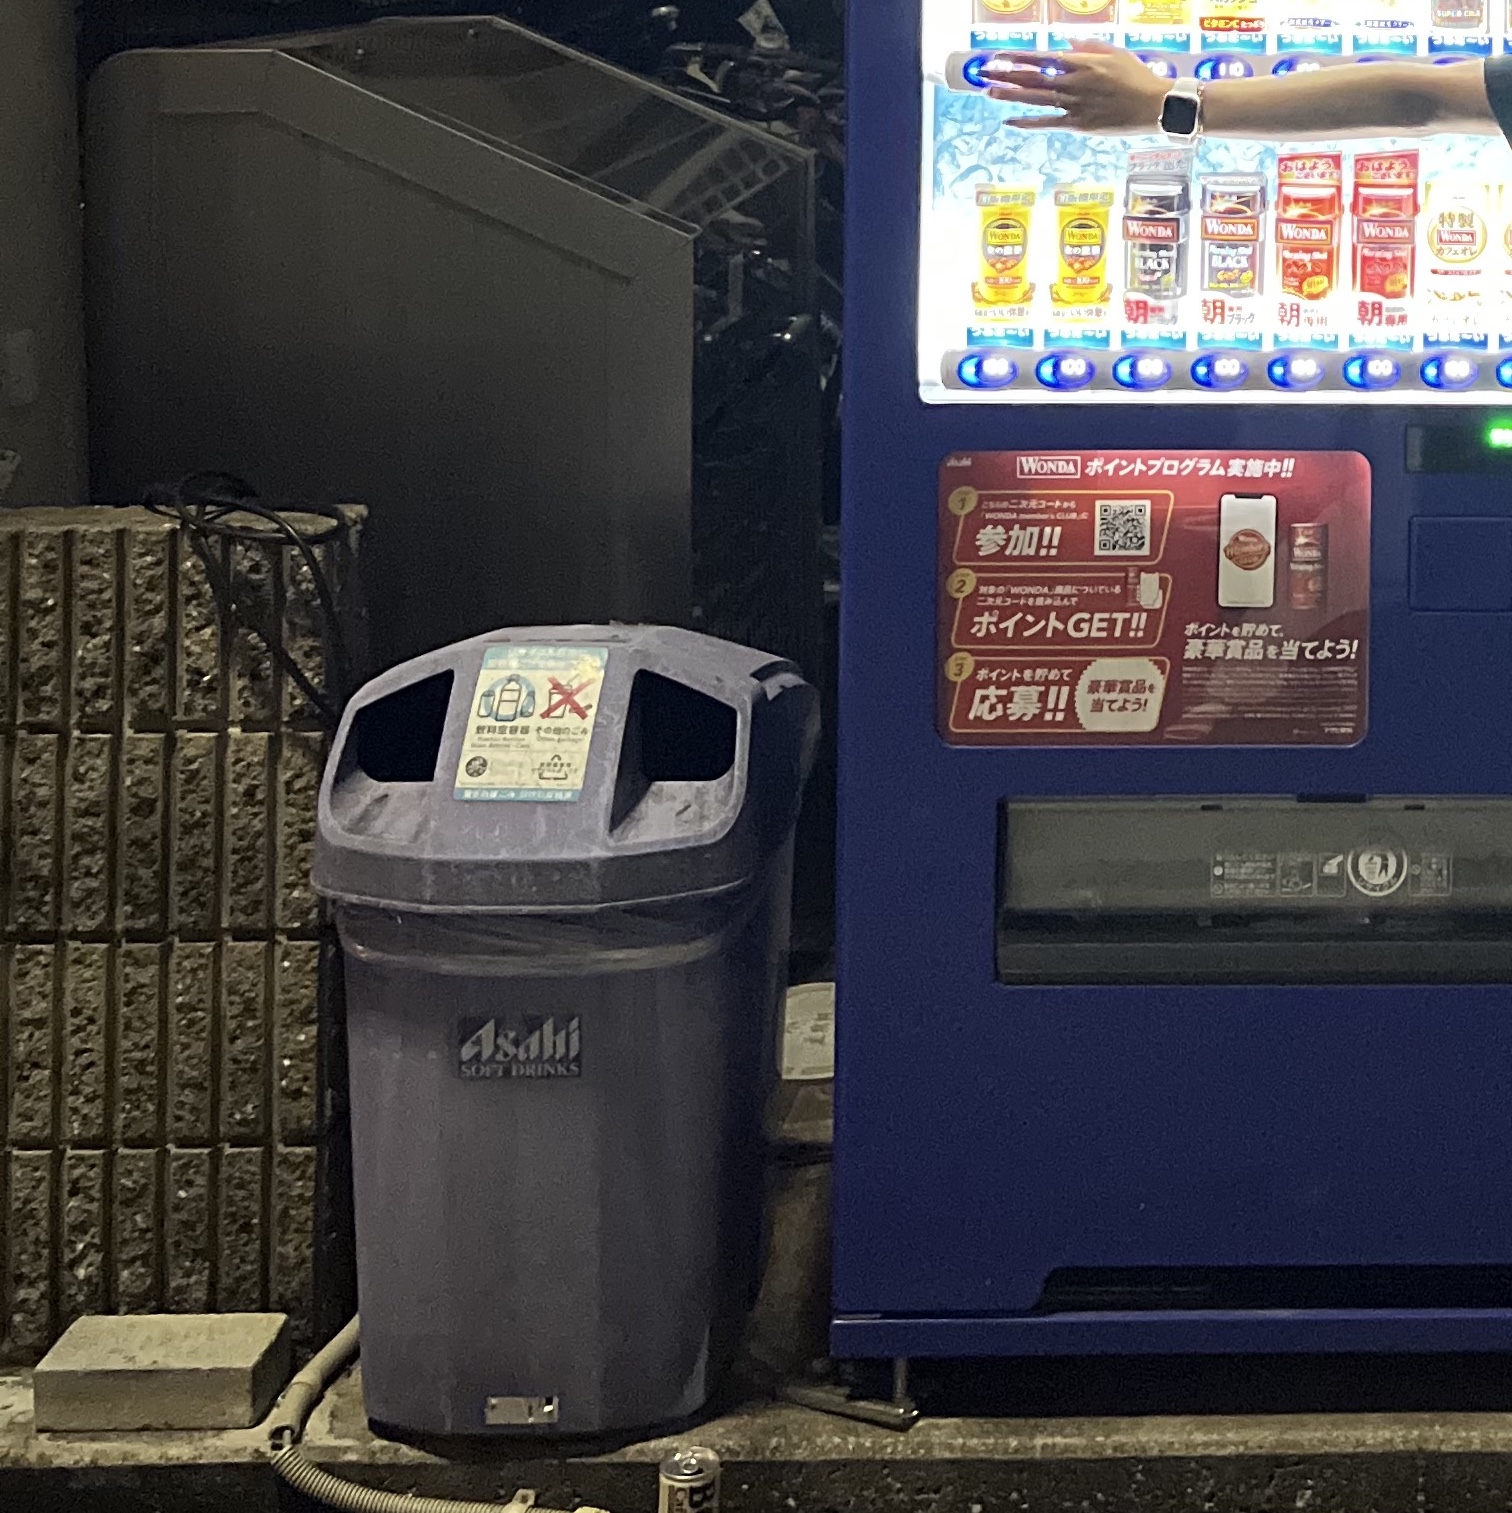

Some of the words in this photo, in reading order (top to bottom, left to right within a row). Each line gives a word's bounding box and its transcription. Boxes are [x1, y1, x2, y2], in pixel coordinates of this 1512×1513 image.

[1280, 157, 1333, 173] おはよう
[1356, 158, 1409, 173] おはよう
[1205, 220, 1254, 236] WONDA
[1437, 212, 1475, 228] 特製
[989, 231, 1021, 241] WONDA
[1067, 231, 1098, 241] WONDA
[1126, 220, 1173, 238] WONDA
[1280, 223, 1328, 240] WONDA
[1362, 222, 1410, 239] WONDA
[1440, 230, 1474, 243] WONDA
[1435, 246, 1479, 257] カフェオレ
[1211, 255, 1249, 268] BLACK
[1124, 299, 1149, 325] 朝
[1200, 299, 1226, 325] 朝
[1278, 302, 1301, 327] 朝
[1357, 300, 1383, 326] 朝
[1019, 457, 1076, 475] WONDA
[1084, 456, 1295, 478] ポイントプログラム実施中!!
[974, 524, 1062, 557] 参加!!
[955, 579, 967, 594] 2
[969, 611, 1148, 639] ポイントGET!!
[1183, 638, 1359, 661] 豪華賞品を当てよう!
[953, 662, 964, 677] 3
[976, 668, 1073, 682] ポイントを貯めて
[1086, 679, 1157, 695] 豪華賞品を
[968, 685, 1071, 722] 応募!!
[1089, 697, 1149, 714] 当てよう!
[460, 1016, 580, 1062] Asahi
[511, 1062, 581, 1077] DRINKS
